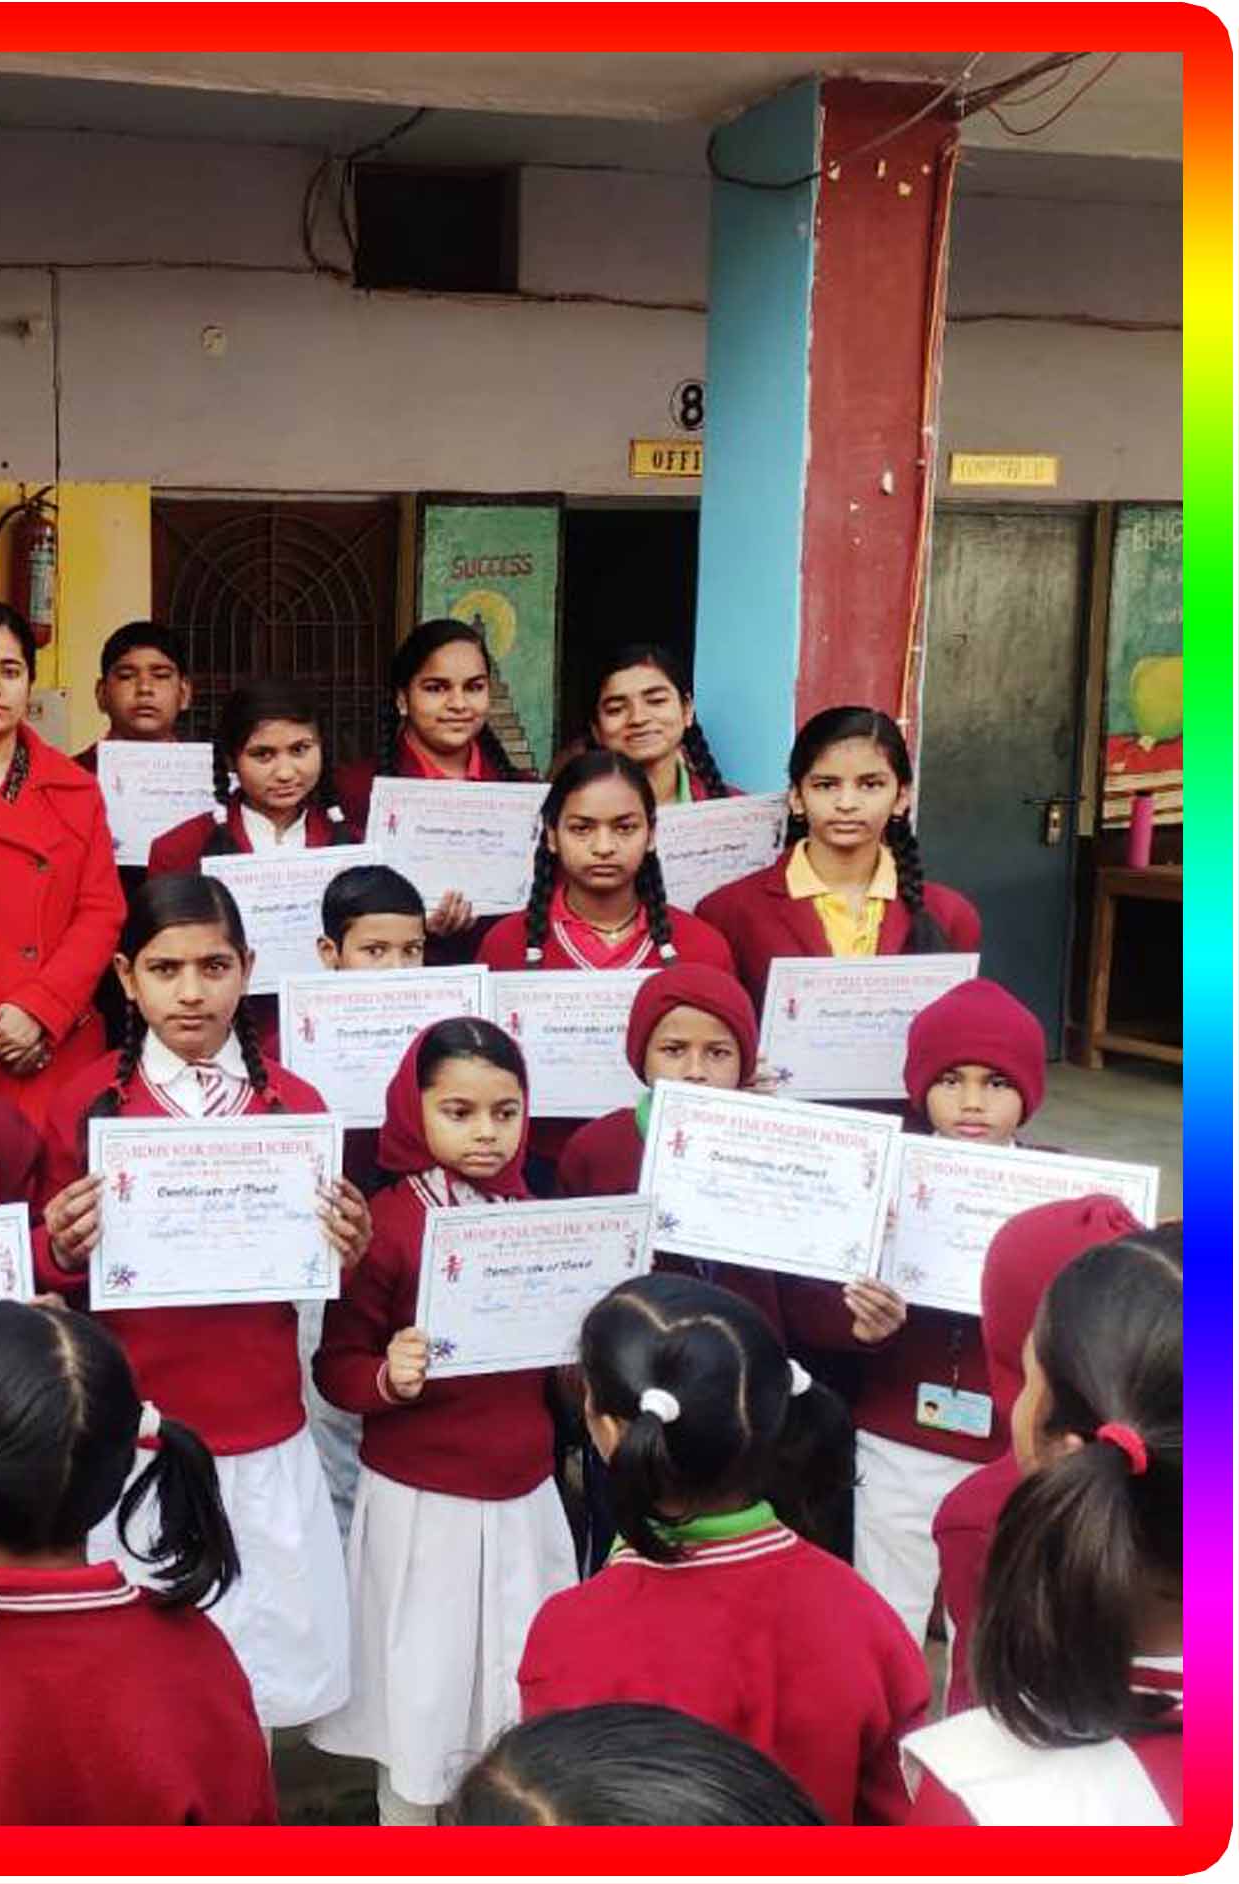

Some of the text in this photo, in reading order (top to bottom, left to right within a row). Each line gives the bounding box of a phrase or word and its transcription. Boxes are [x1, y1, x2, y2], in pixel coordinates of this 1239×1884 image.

[680, 383, 704, 427] 8
[652, 450, 700, 471] OFFI
[451, 552, 533, 579] SUCCESS
